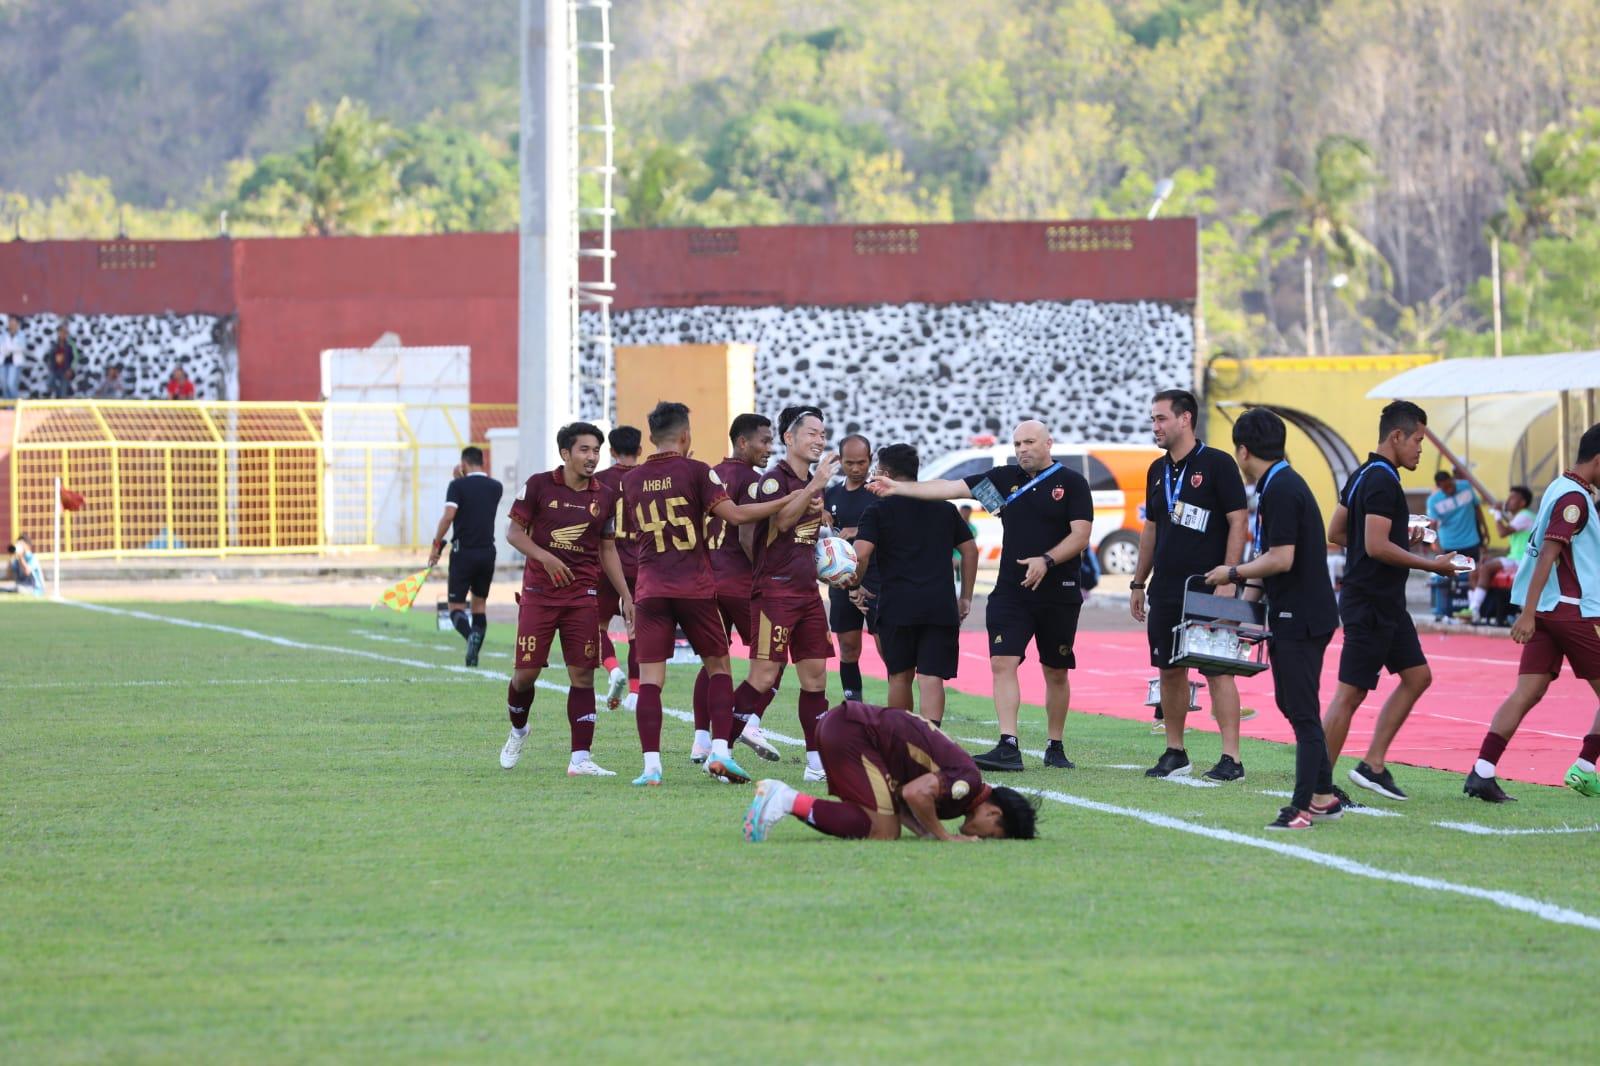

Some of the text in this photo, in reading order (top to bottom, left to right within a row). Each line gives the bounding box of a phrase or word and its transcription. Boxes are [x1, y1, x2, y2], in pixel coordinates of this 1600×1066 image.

[642, 477, 672, 492] AKBAR
[615, 497, 637, 540] 1
[635, 497, 696, 553] 45
[549, 541, 585, 553] HONDA
[772, 625, 789, 644] 39
[518, 636, 536, 651] 48
